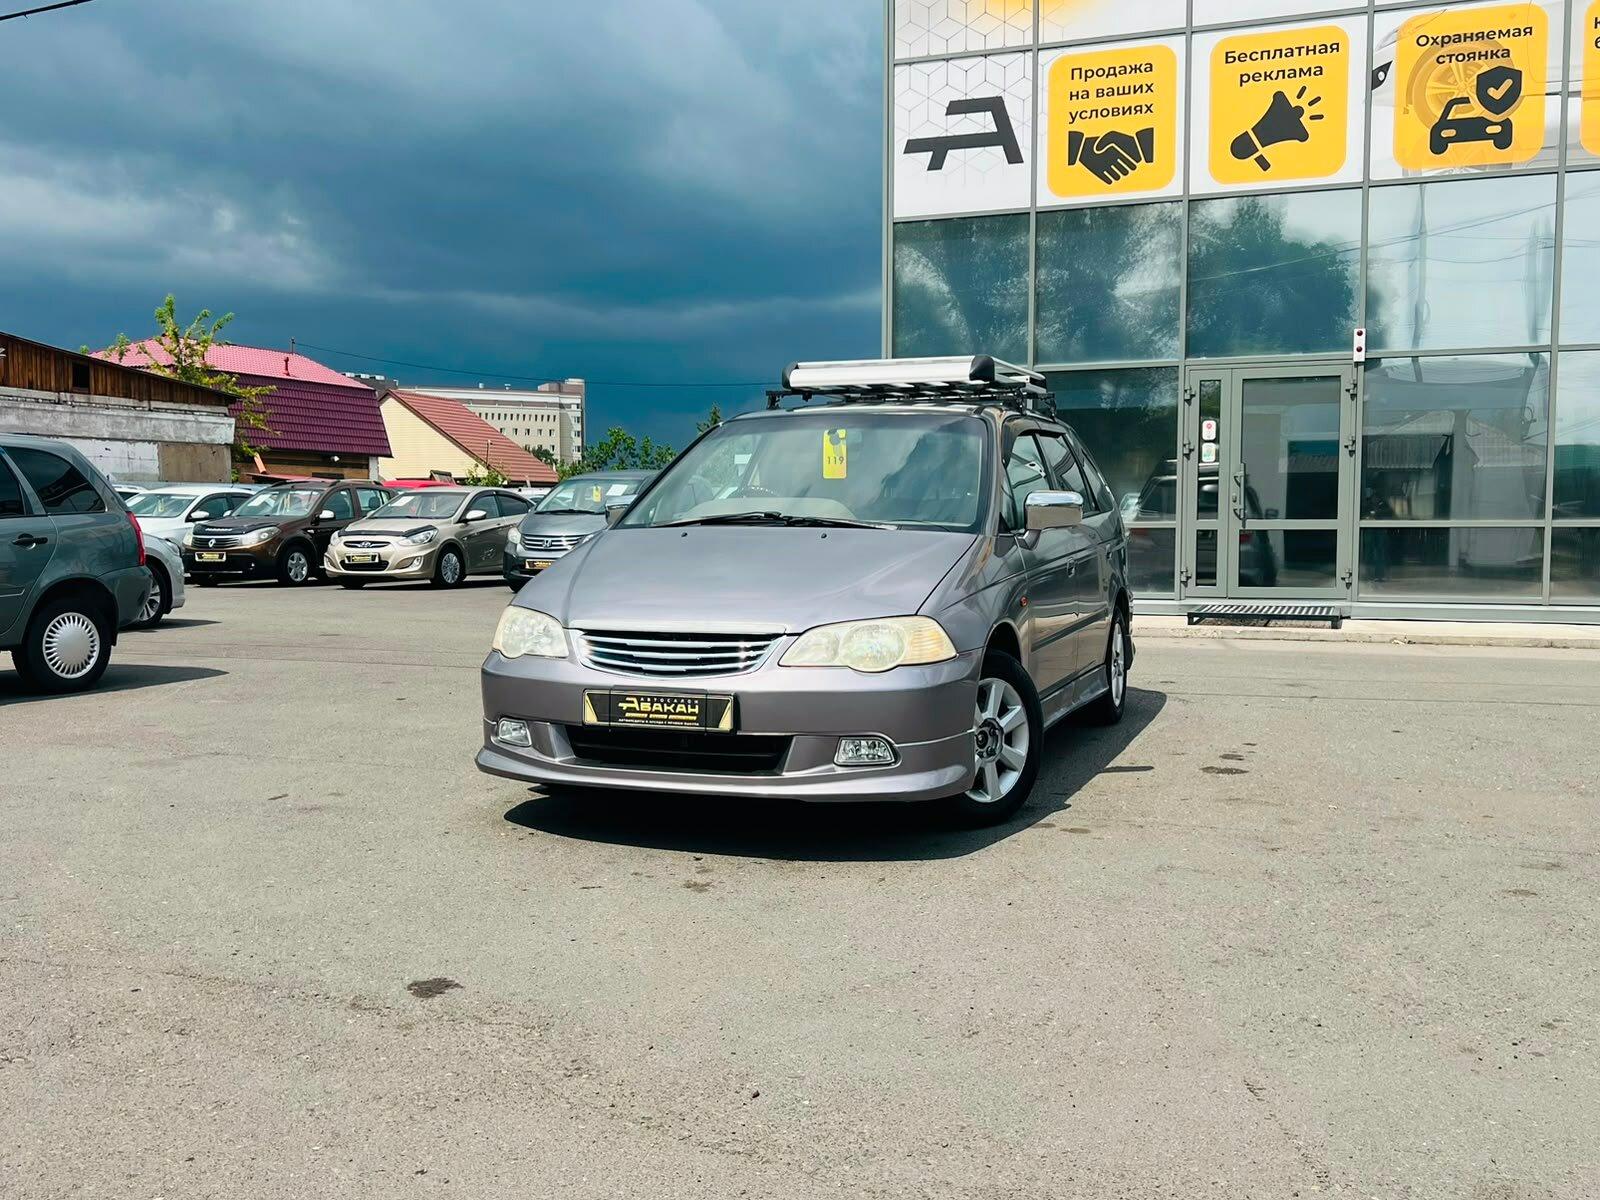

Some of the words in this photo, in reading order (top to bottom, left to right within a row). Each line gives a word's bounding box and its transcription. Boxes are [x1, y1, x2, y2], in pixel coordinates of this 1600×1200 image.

[1416, 25, 1533, 48] Охраняемая
[1224, 41, 1340, 65] Бесплатная
[1436, 47, 1511, 65] стоянка
[1070, 61, 1154, 82] Продажа
[1239, 64, 1324, 87] реклама
[1069, 89, 1090, 101] на
[1096, 81, 1154, 98] ваших
[1068, 102, 1154, 124] условиях
[827, 456, 845, 465] 119
